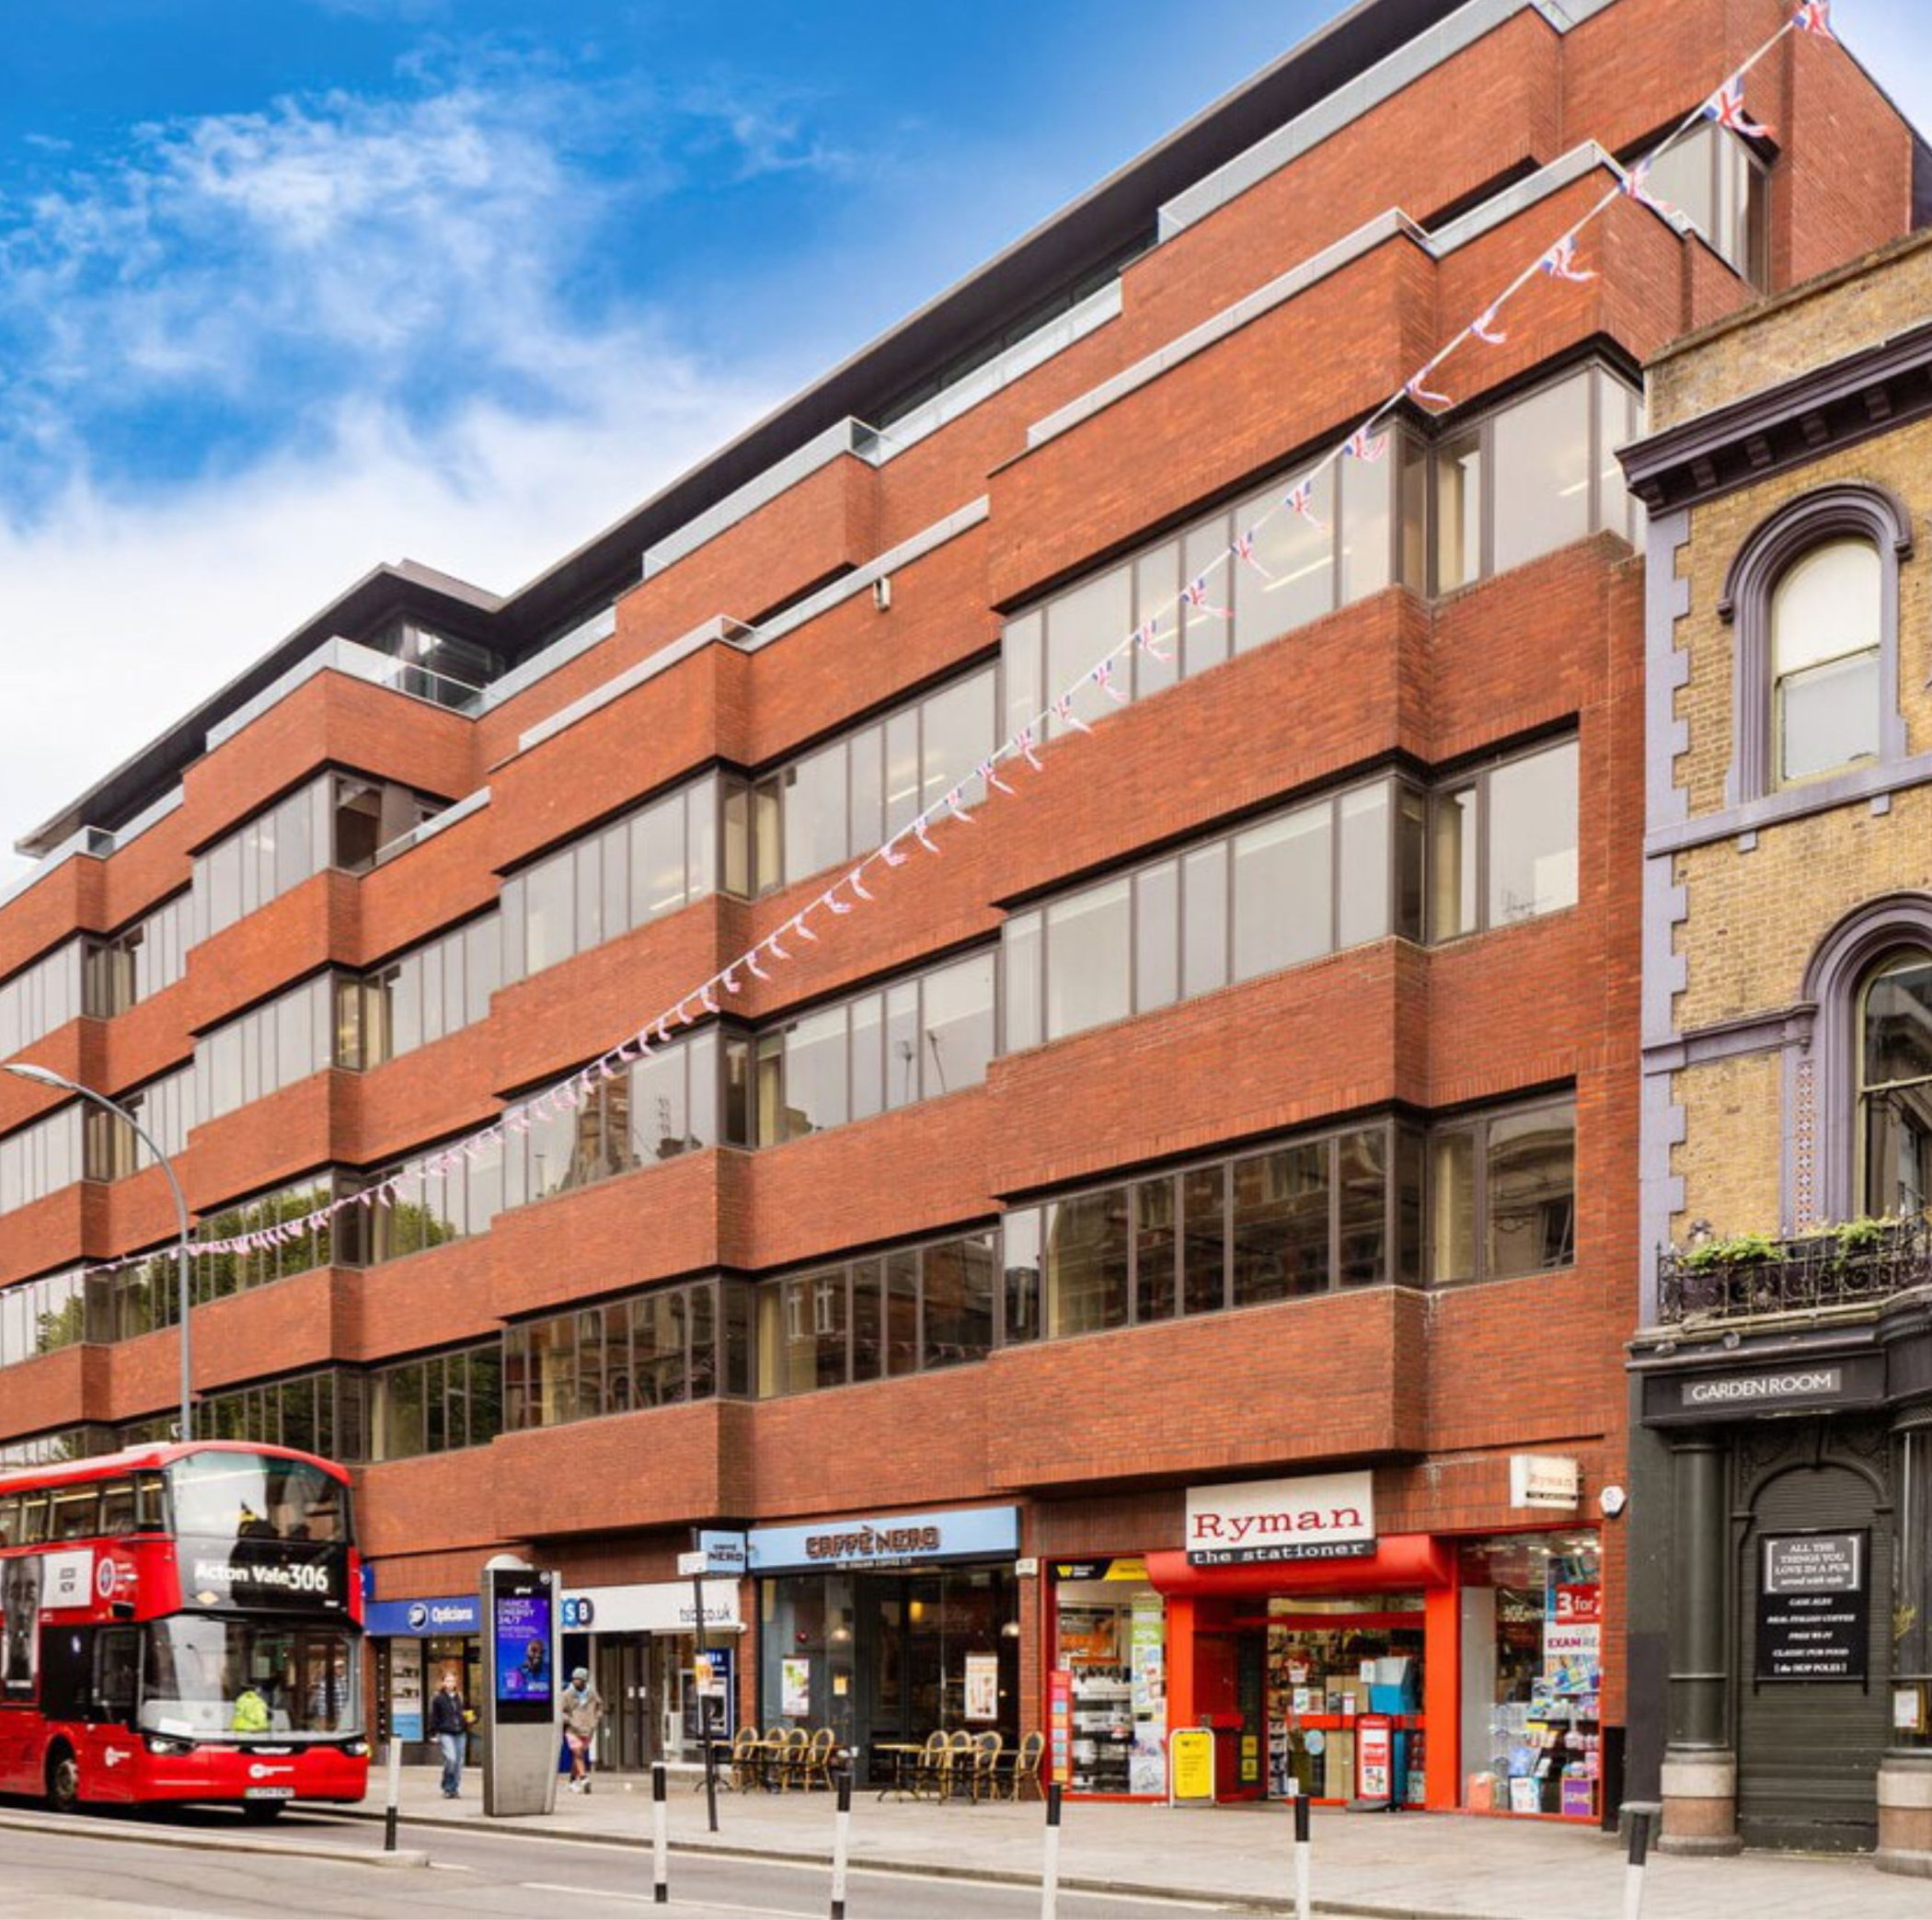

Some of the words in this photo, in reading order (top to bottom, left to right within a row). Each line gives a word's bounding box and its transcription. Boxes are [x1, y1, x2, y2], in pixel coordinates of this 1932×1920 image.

[1692, 1380, 1765, 1400] GARDEN
[1768, 1374, 1832, 1393] ROOM
[1192, 1507, 1363, 1542] Ryman
[805, 1525, 876, 1559] CAFFÈ
[876, 1526, 940, 1553] NERO
[707, 1551, 744, 1562] NERO
[1192, 1551, 1232, 1564] the
[1242, 1543, 1365, 1561] stationer
[1823, 1553, 1845, 1562] YOU
[194, 1564, 249, 1582] Acton
[252, 1566, 290, 1584] Vale
[288, 1564, 329, 1591] 306
[1558, 1592, 1574, 1616] 3
[1574, 1595, 1595, 1611] for
[431, 1606, 473, 1625] Opticians
[1547, 1637, 1581, 1649] EXAM
